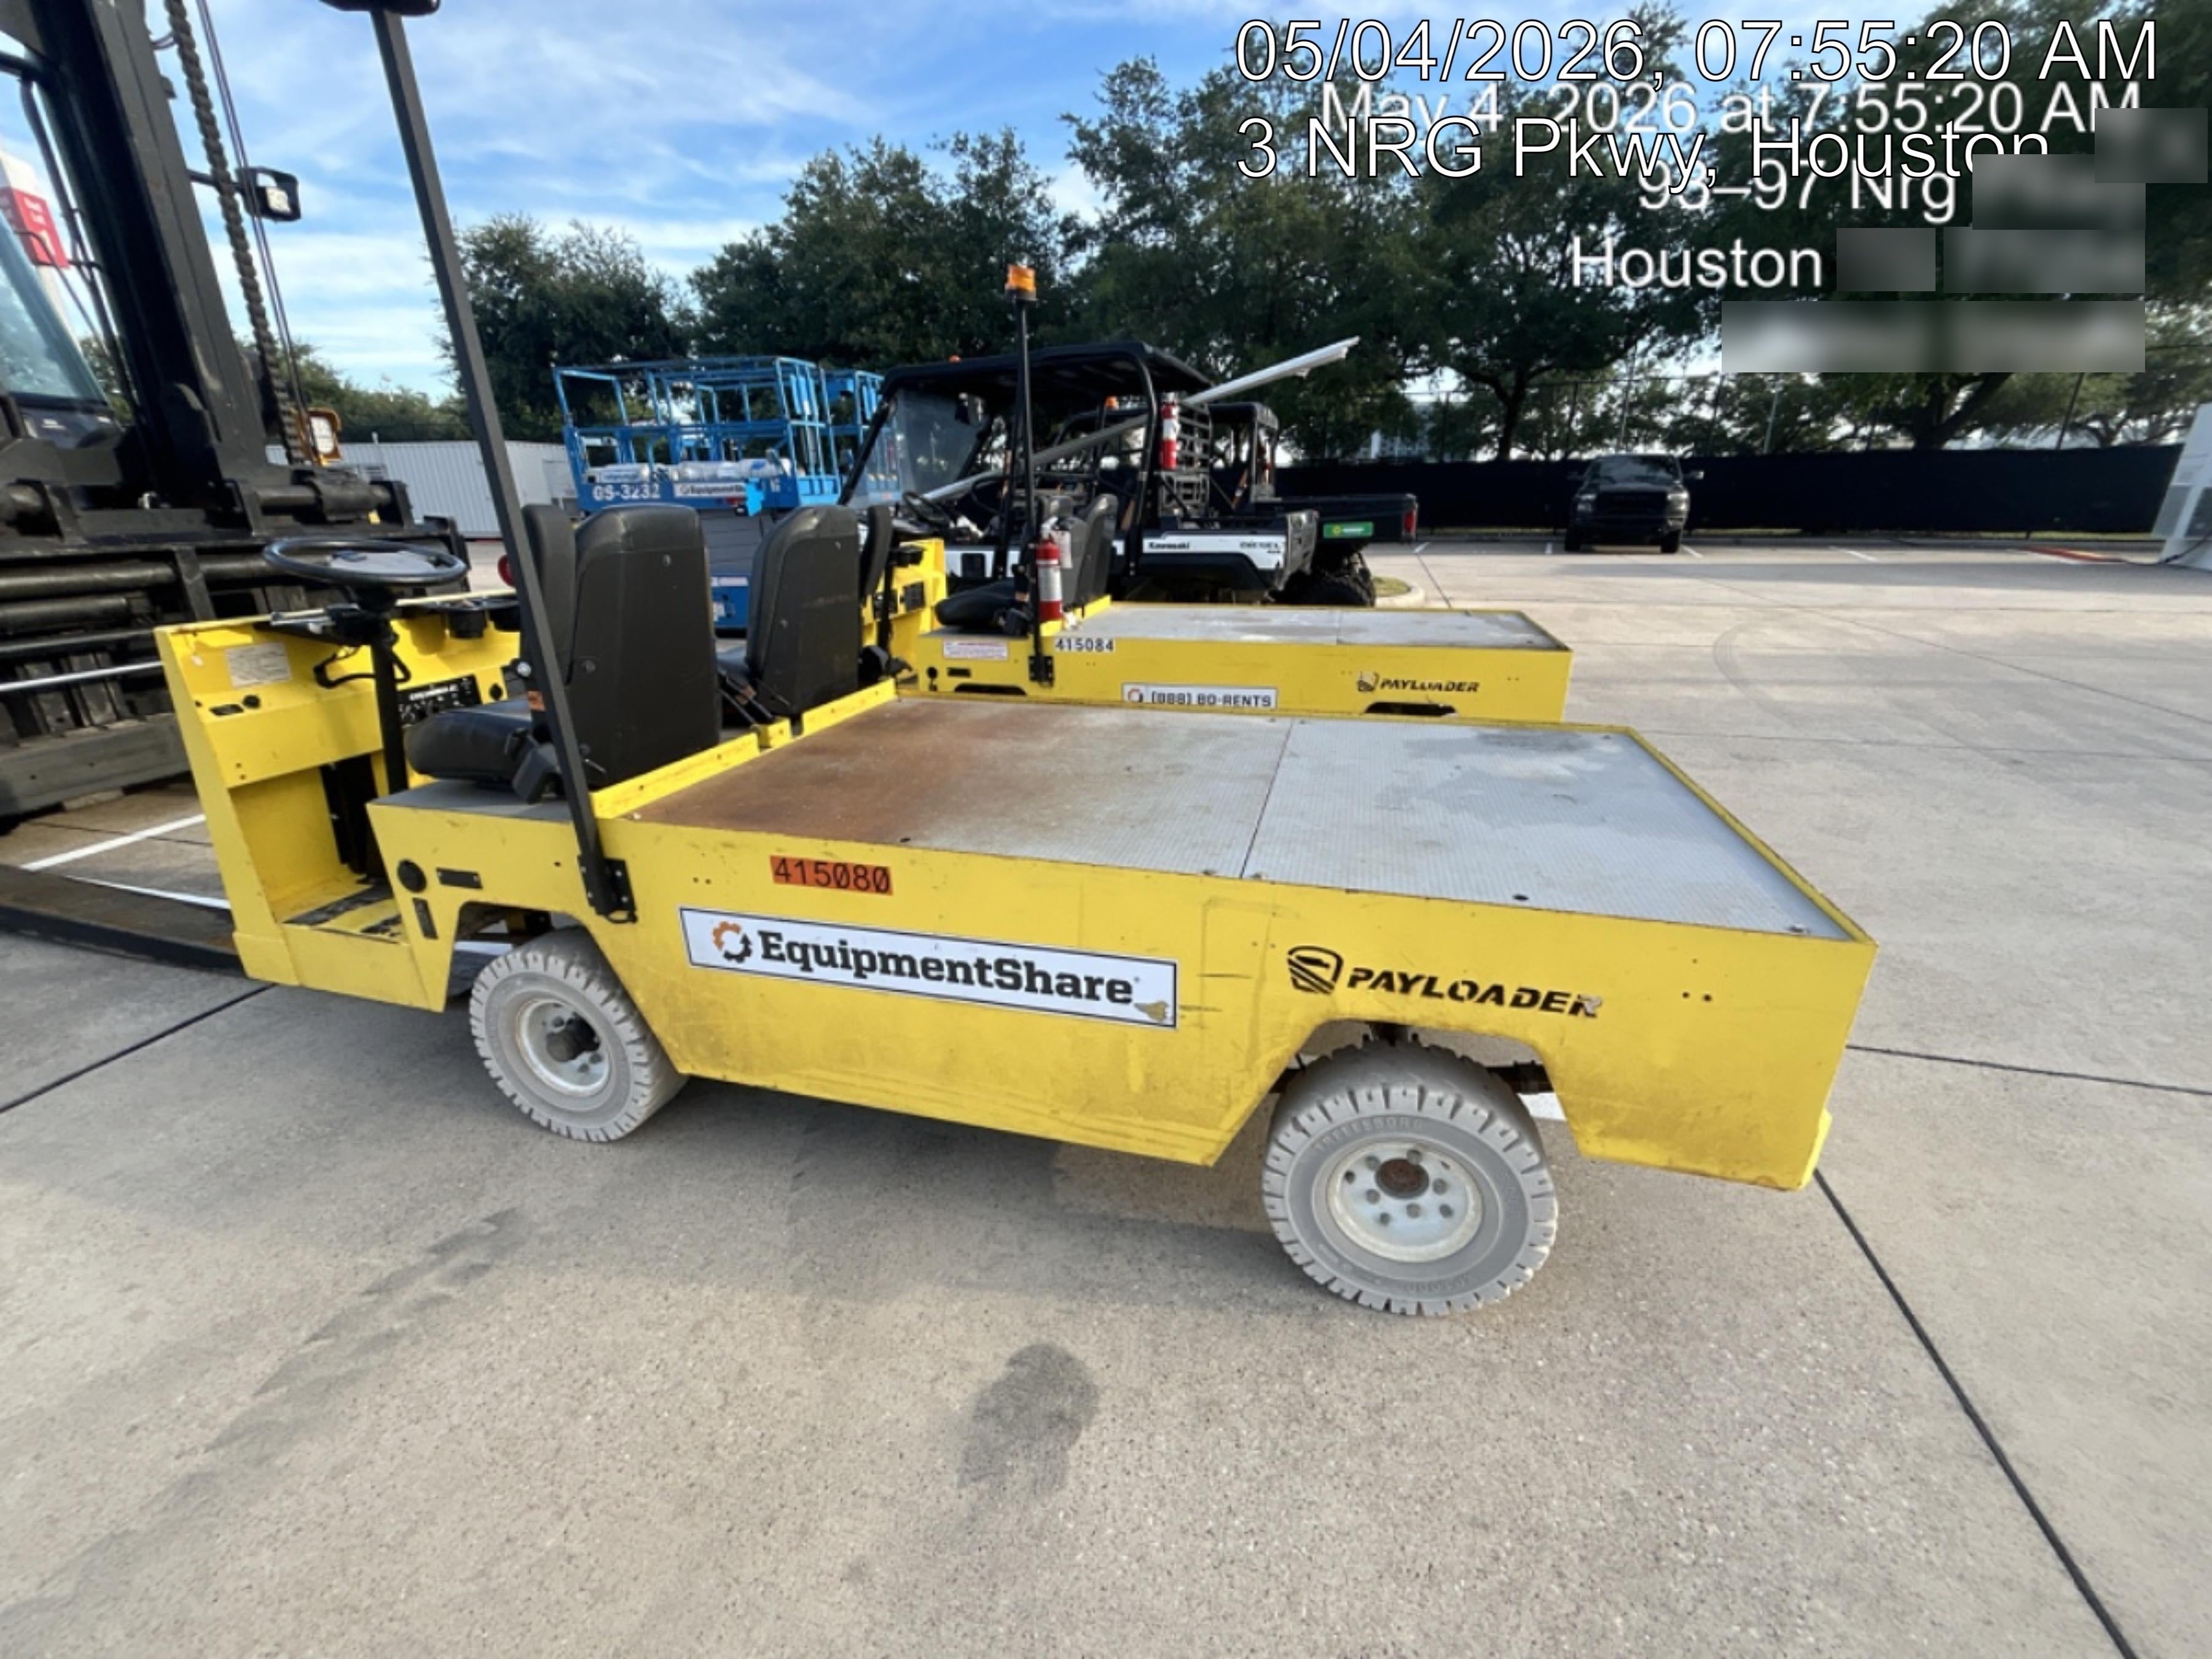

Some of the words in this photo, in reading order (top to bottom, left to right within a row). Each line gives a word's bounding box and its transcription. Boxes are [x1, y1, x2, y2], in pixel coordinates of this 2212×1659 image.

[592, 484, 661, 501] GS-3232
[1054, 637, 1115, 652] 415084
[773, 857, 892, 894] 415080
[758, 930, 1135, 1007] EquipmentShare
[1346, 967, 1602, 1018] PAYLOADER
